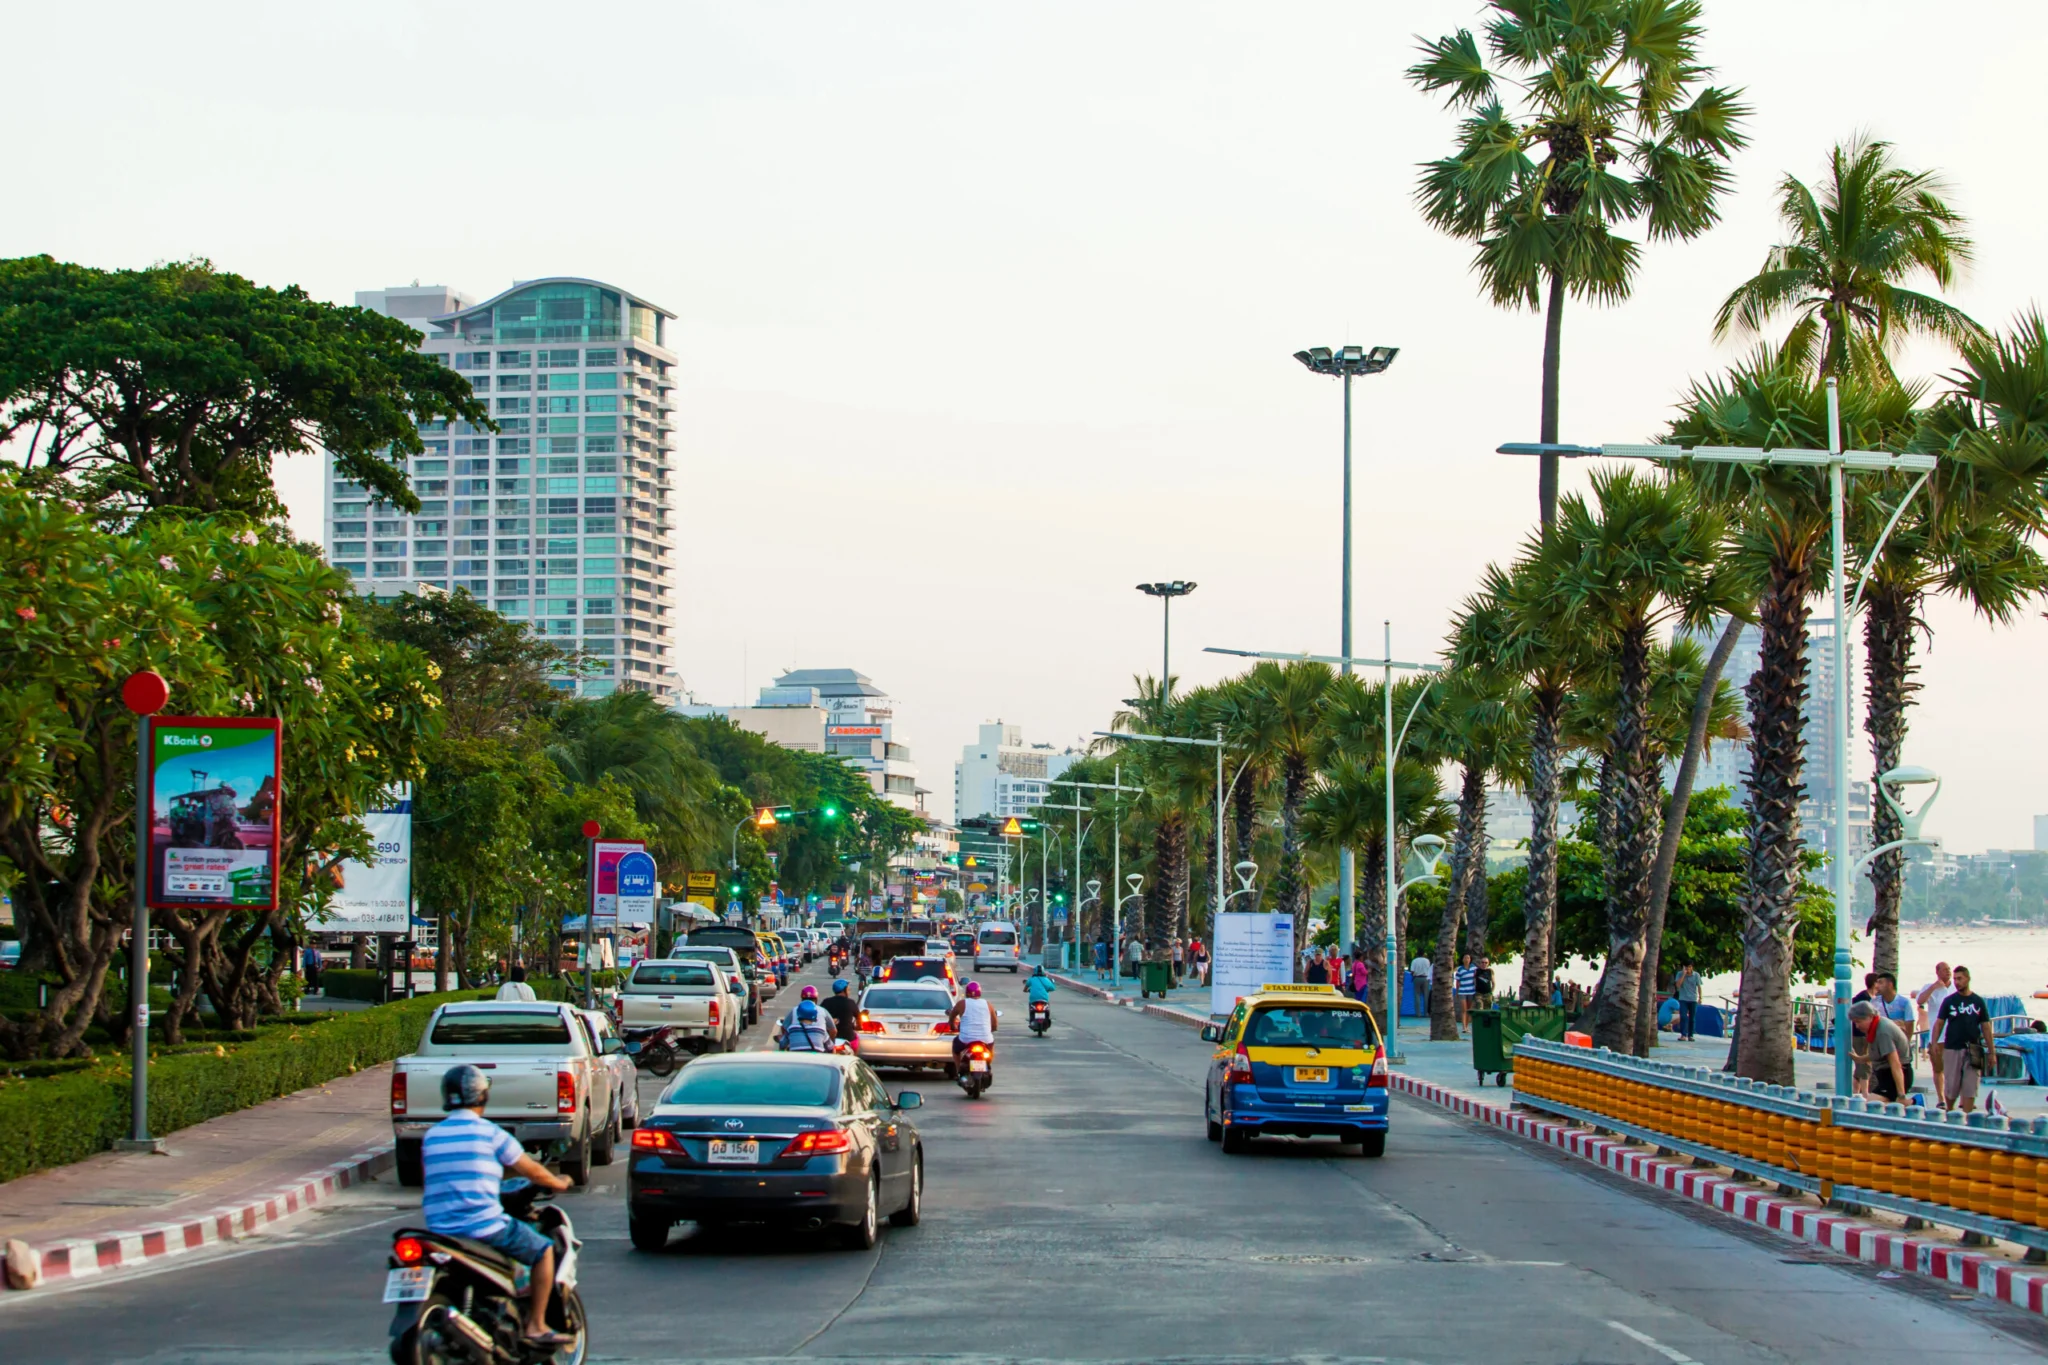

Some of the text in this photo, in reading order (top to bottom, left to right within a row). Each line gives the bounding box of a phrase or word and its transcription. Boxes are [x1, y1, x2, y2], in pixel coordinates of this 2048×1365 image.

[163, 734, 199, 746] KBank
[377, 842, 400, 853] 690
[731, 1143, 755, 1153] 1540
